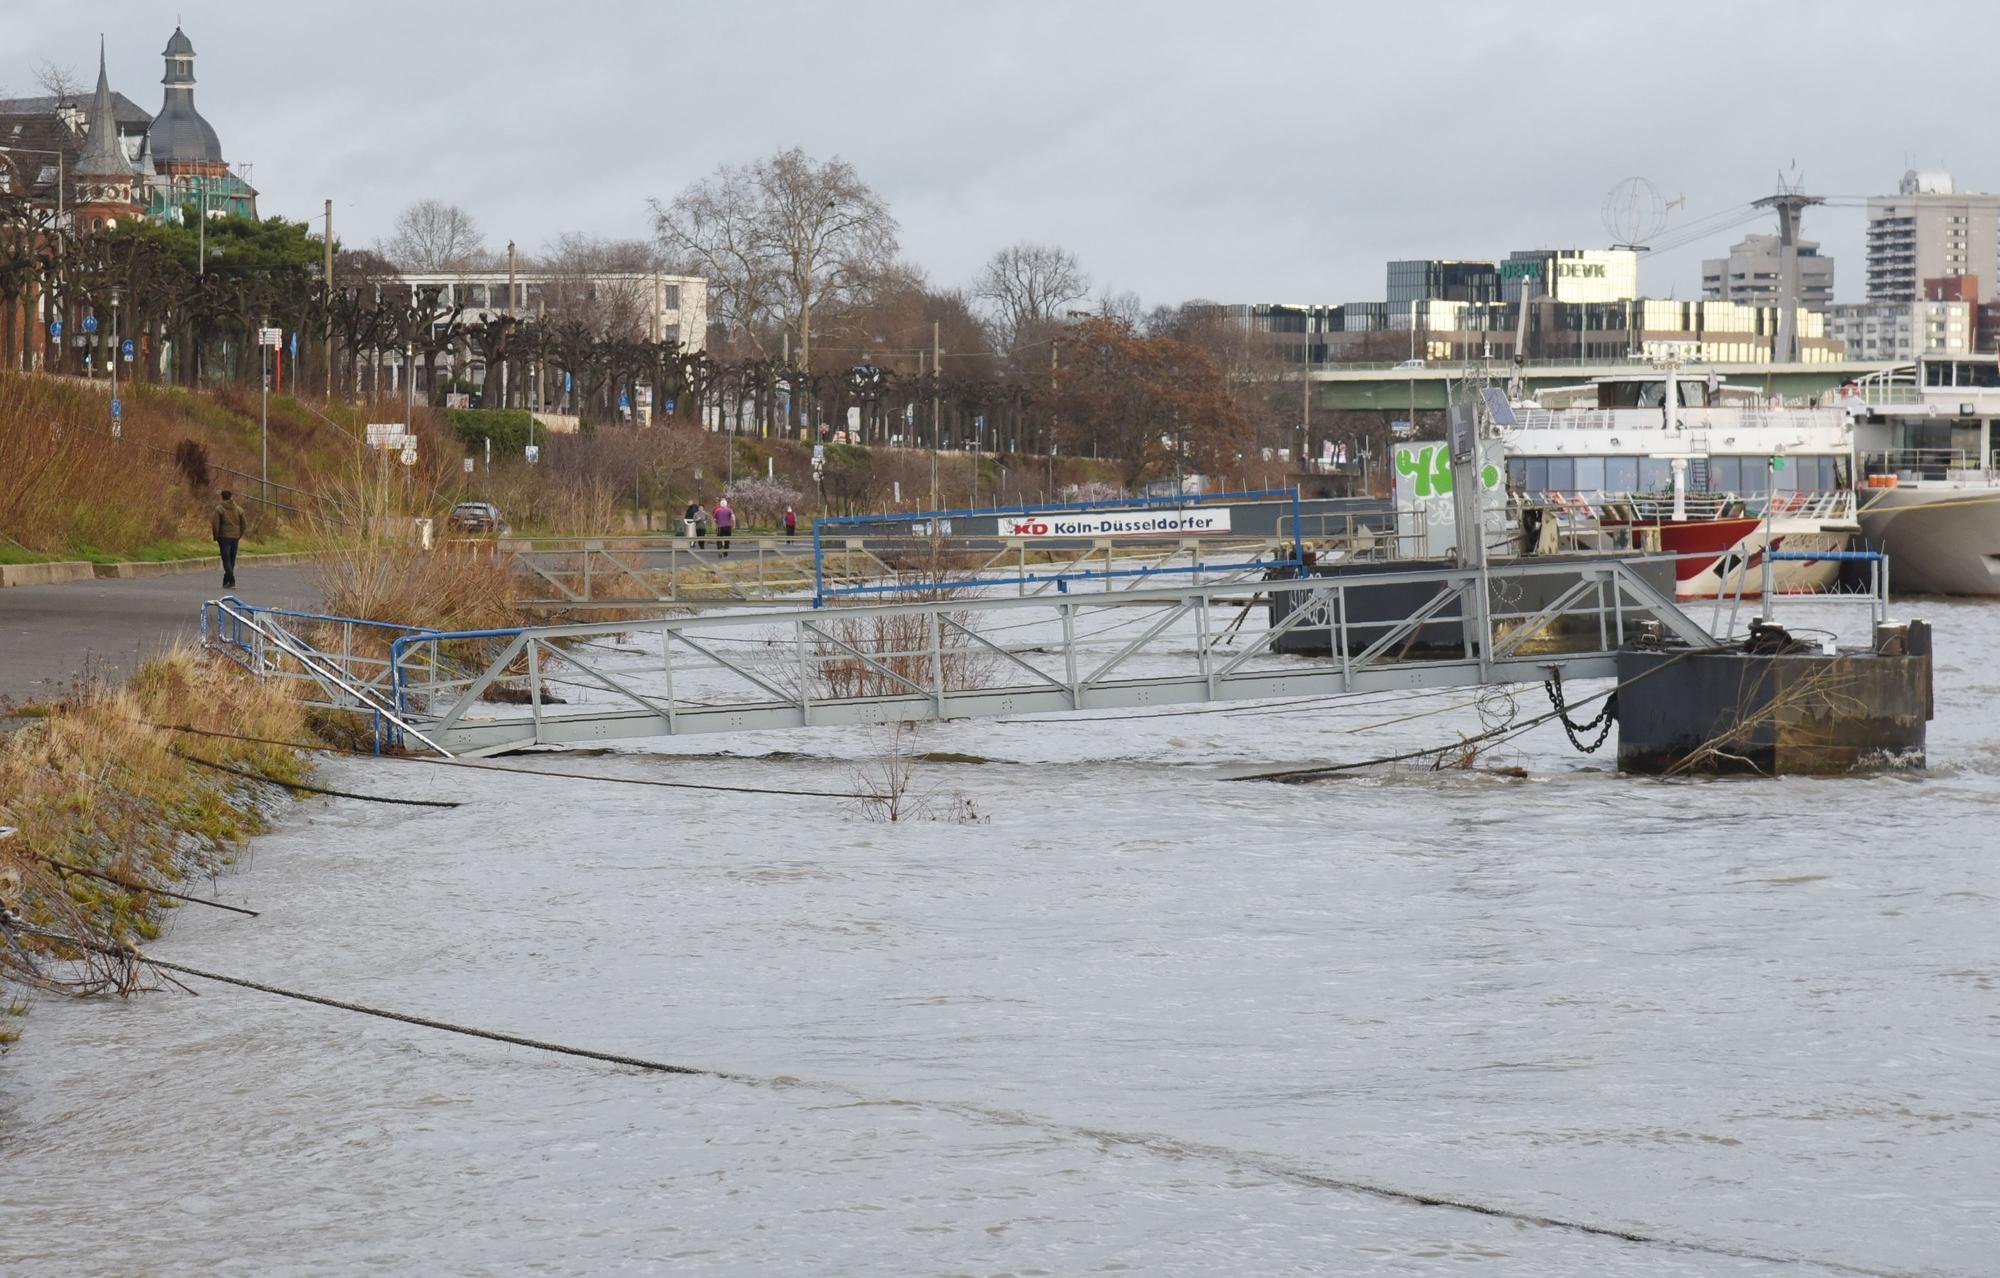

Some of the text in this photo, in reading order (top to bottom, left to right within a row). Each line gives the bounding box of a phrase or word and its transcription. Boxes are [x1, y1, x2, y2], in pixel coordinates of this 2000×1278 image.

[1557, 263, 1606, 278] DEVK
[1014, 516, 1214, 535] KD Köln-Düsseldorfer
